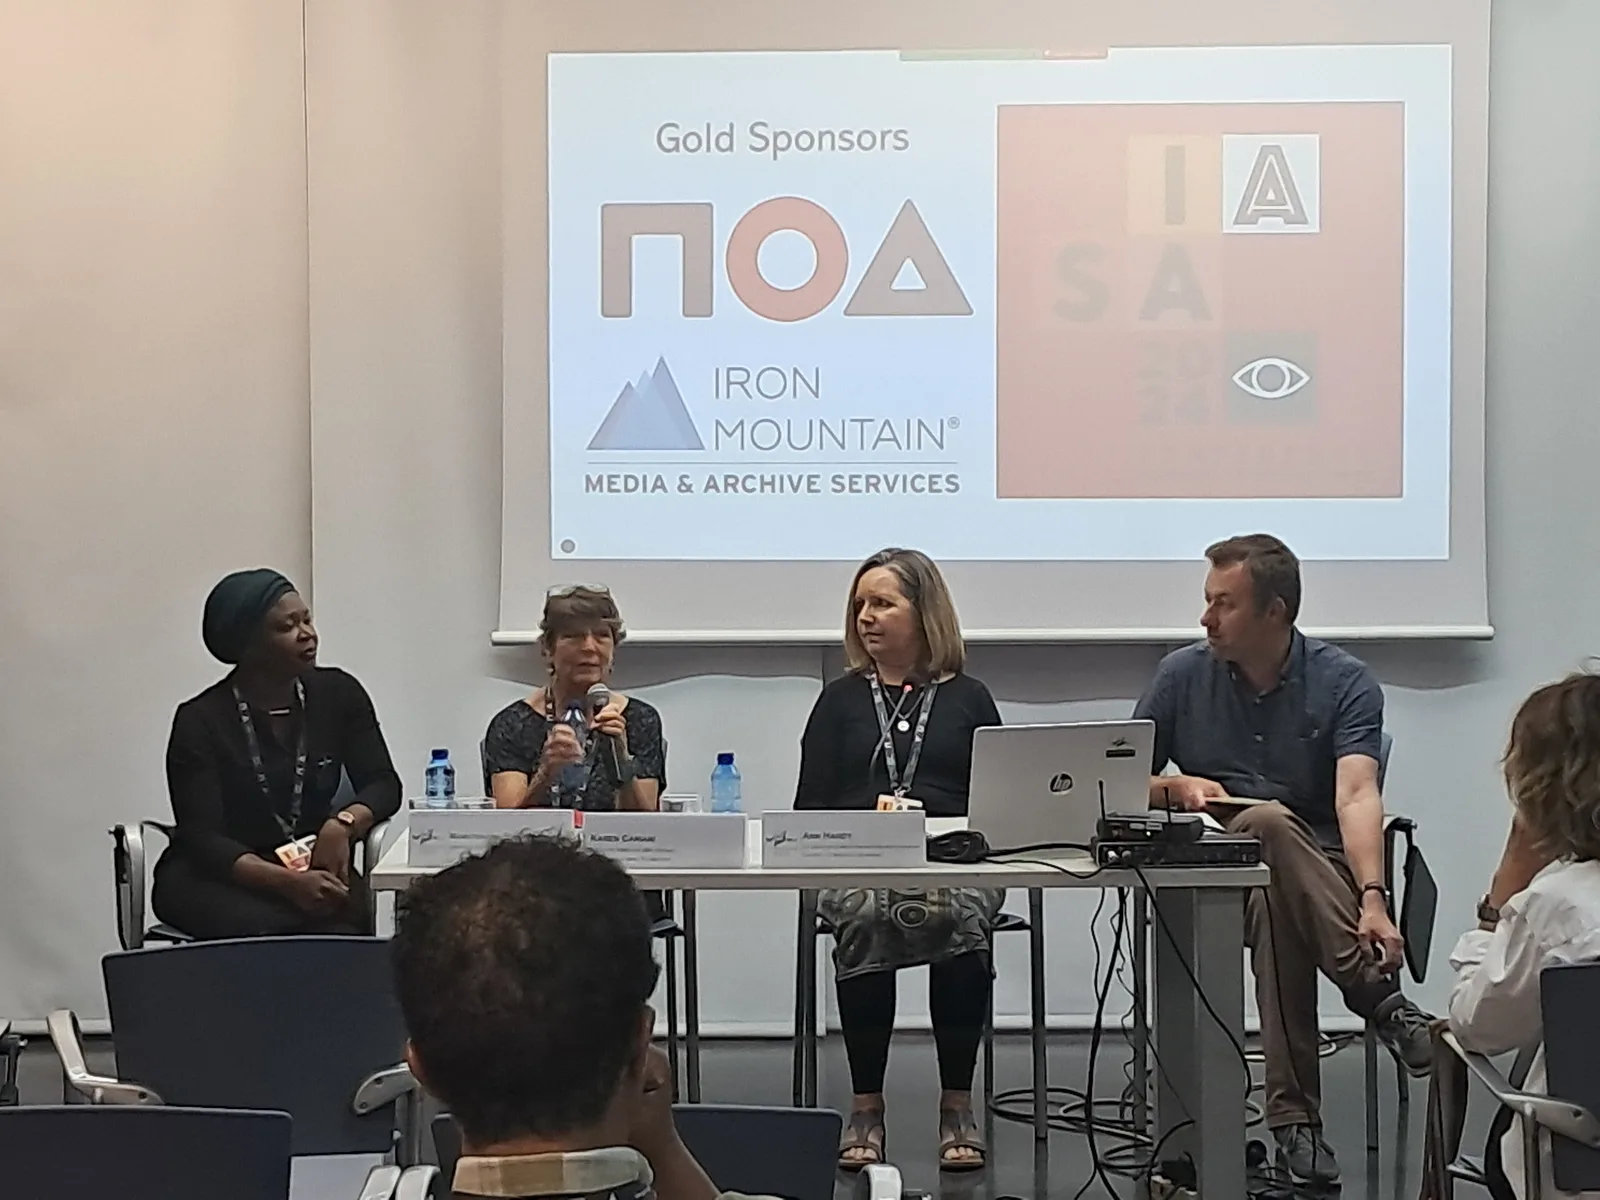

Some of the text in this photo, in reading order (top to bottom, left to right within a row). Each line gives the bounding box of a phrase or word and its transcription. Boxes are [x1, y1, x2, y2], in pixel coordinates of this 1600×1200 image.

[656, 120, 910, 161] Gold Sponsors
[714, 366, 821, 400] IRON
[584, 472, 961, 494] MEDIA & ARCHIVE SERVICES
[1051, 773, 1073, 793] hp
